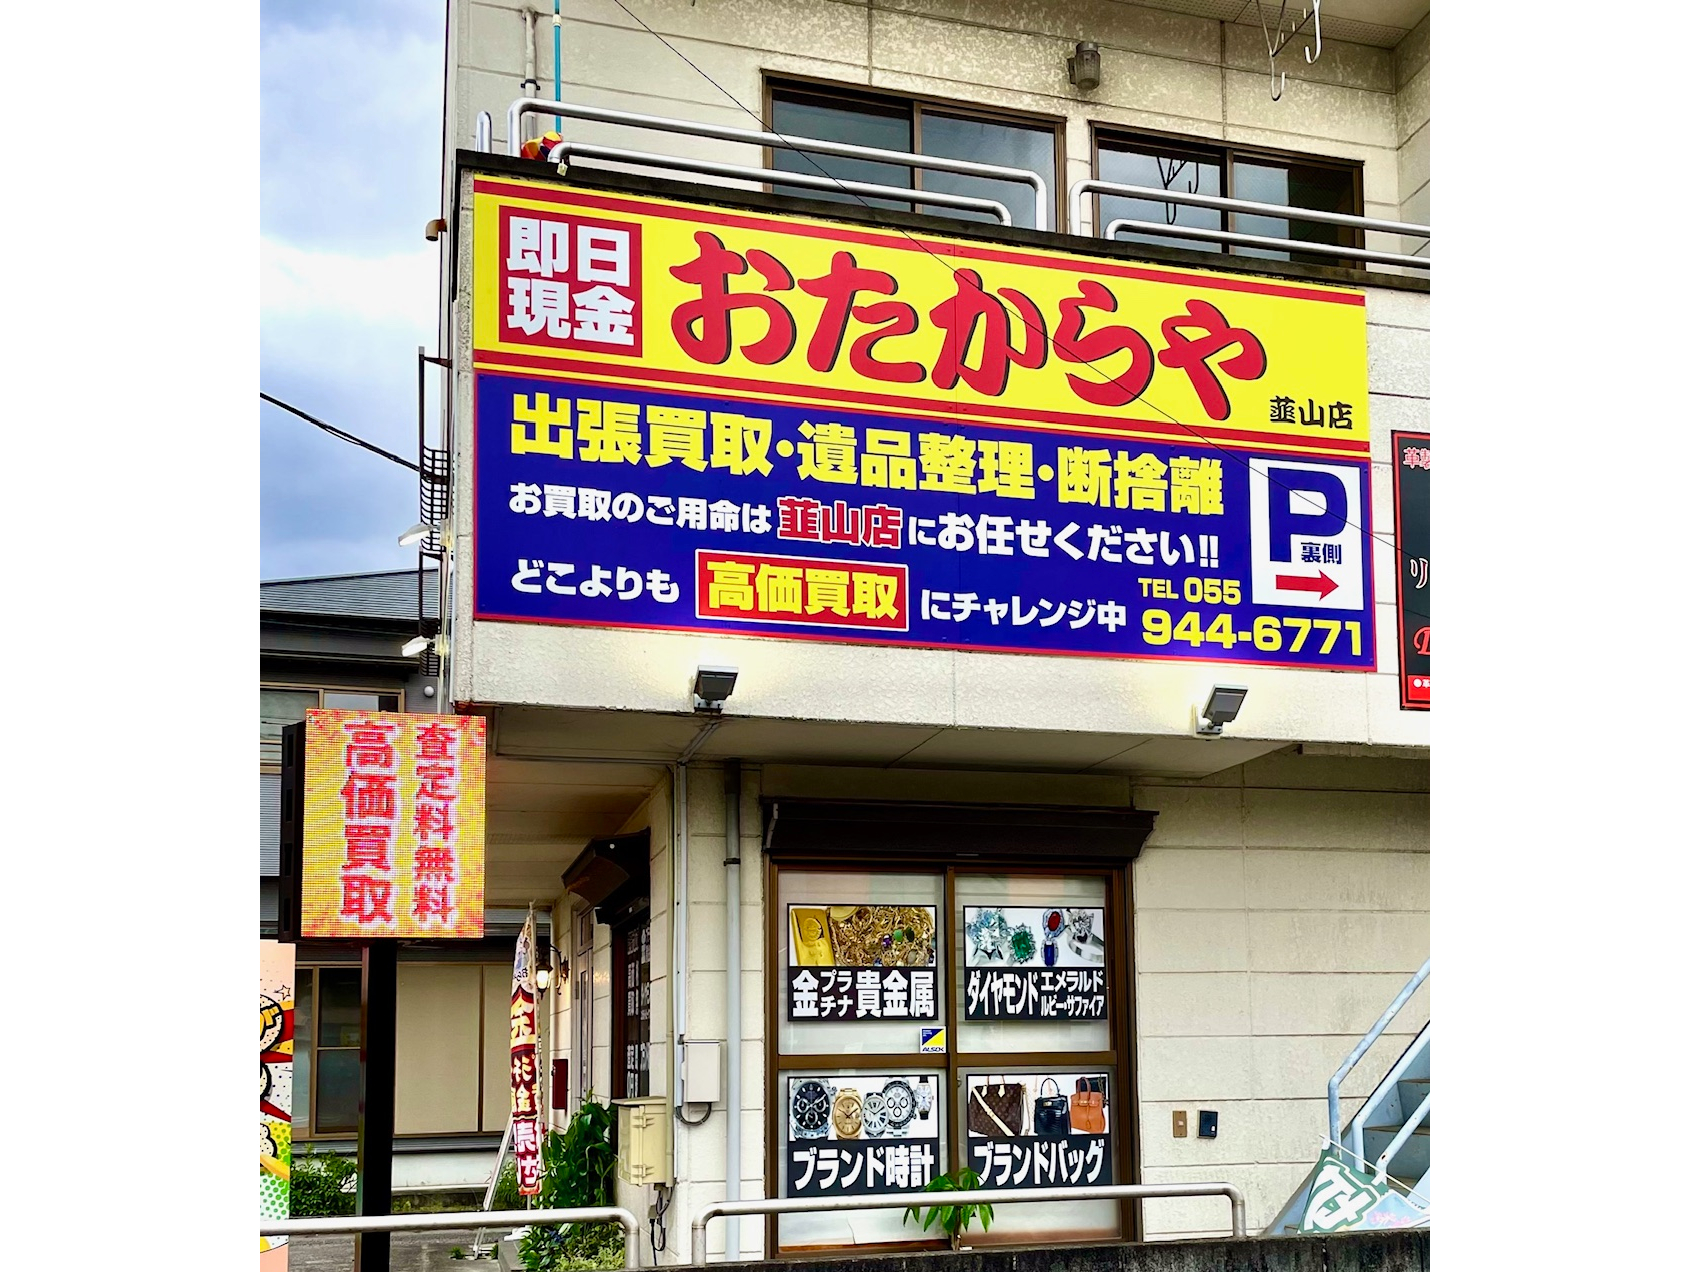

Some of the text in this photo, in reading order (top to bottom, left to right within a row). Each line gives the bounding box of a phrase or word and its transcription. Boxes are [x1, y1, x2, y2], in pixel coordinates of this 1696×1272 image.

[506, 216, 631, 288] 即日
[506, 277, 635, 346] 現金
[669, 231, 1267, 421] おたからや
[1270, 395, 1353, 429] 韮山店
[508, 482, 772, 534] お買取のご用命は
[777, 497, 902, 548] 韮山店
[1268, 467, 1348, 562] P
[1301, 542, 1342, 564] 裏側
[510, 558, 1127, 632] どこよりも 高価買取 にチャレンジ中
[1138, 576, 1241, 605] TEL 055
[1142, 611, 1362, 656] 944-6771
[340, 720, 398, 924] 高価買取
[412, 722, 457, 924] 査定料無料
[792, 969, 819, 1017] 金
[855, 969, 935, 1018] 貴金属
[967, 970, 1104, 1015] ダイヤモンド エメラルド
[1041, 994, 1104, 1016] ルビー・サファイア
[793, 1143, 935, 1190] ブランド時計
[973, 1138, 1105, 1187] ブランドバッグ
